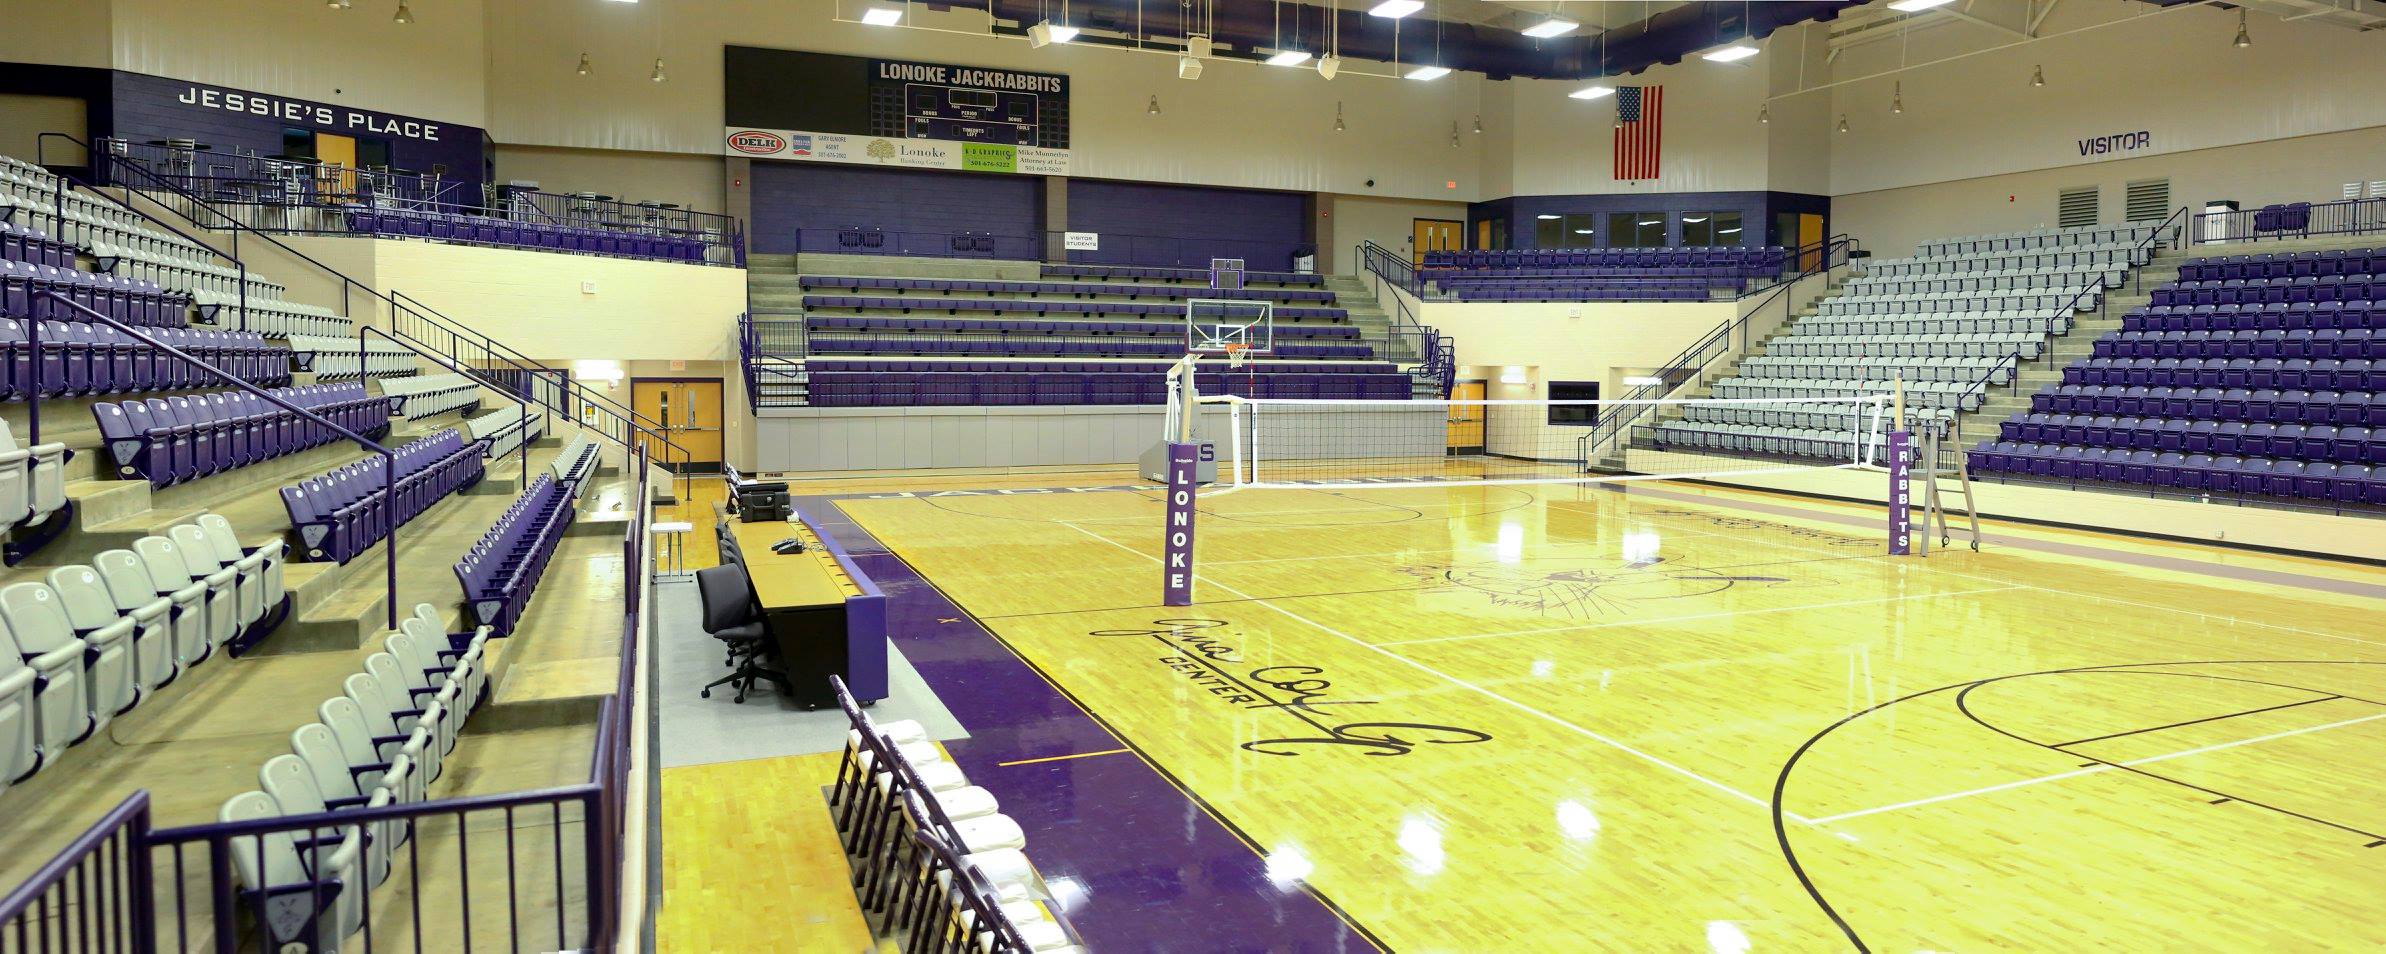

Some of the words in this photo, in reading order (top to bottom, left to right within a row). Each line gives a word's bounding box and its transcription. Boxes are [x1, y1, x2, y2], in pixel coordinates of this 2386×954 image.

[880, 62, 946, 84] LONOKE
[951, 68, 1061, 93] JACKRABBITS
[179, 87, 333, 125] JESSIE'S
[348, 112, 439, 141] PLACE
[738, 137, 776, 148] DELK
[901, 145, 946, 158] Lonoke
[2078, 130, 2150, 156] VISITOR
[1898, 450, 1909, 547] RABBITS
[1171, 469, 1190, 589] LONOKE
[1158, 655, 1256, 705] CENTER
